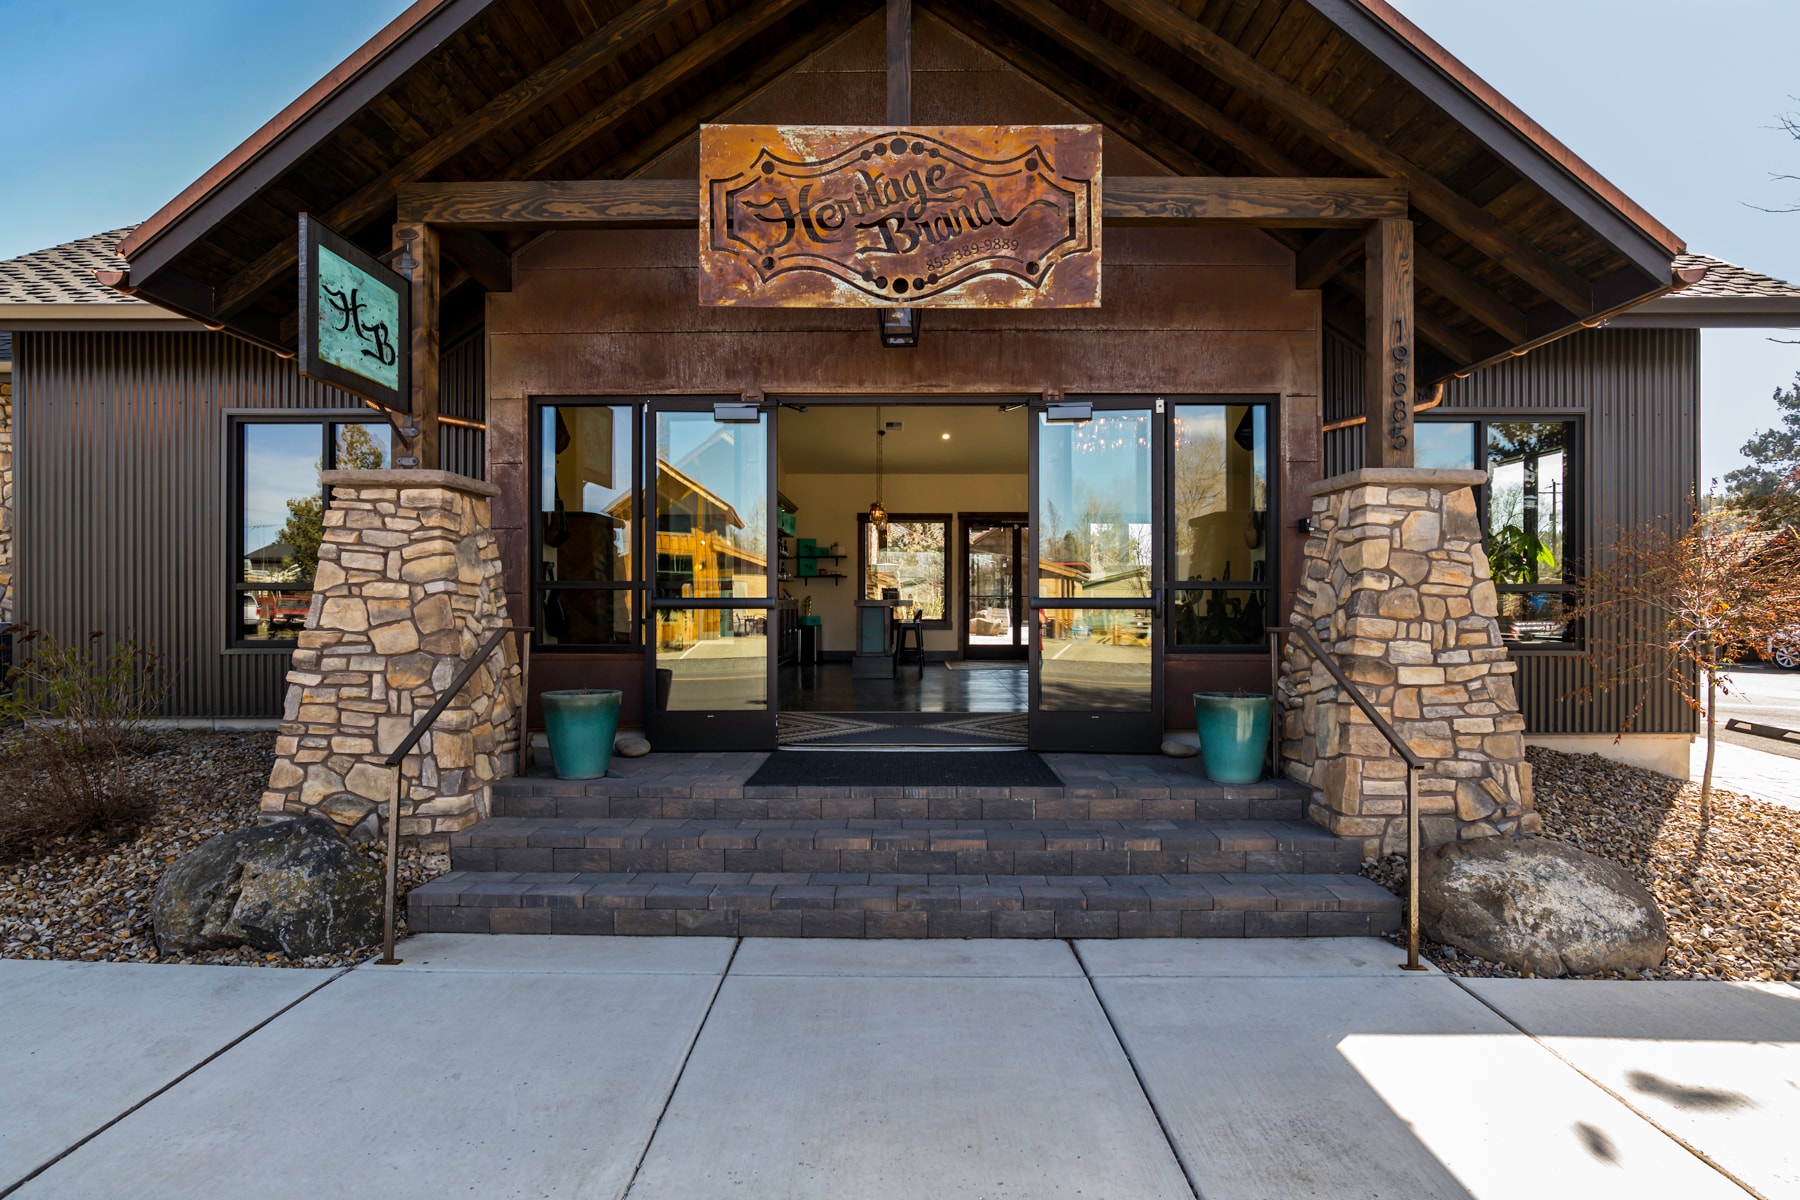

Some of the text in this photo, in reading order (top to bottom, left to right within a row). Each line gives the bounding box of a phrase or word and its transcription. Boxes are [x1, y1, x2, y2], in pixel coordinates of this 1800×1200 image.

[742, 164, 971, 248] Heritage
[854, 180, 1061, 255] Brand
[926, 238, 1019, 272] 855-389-9889
[1391, 319, 1408, 451] 19885
